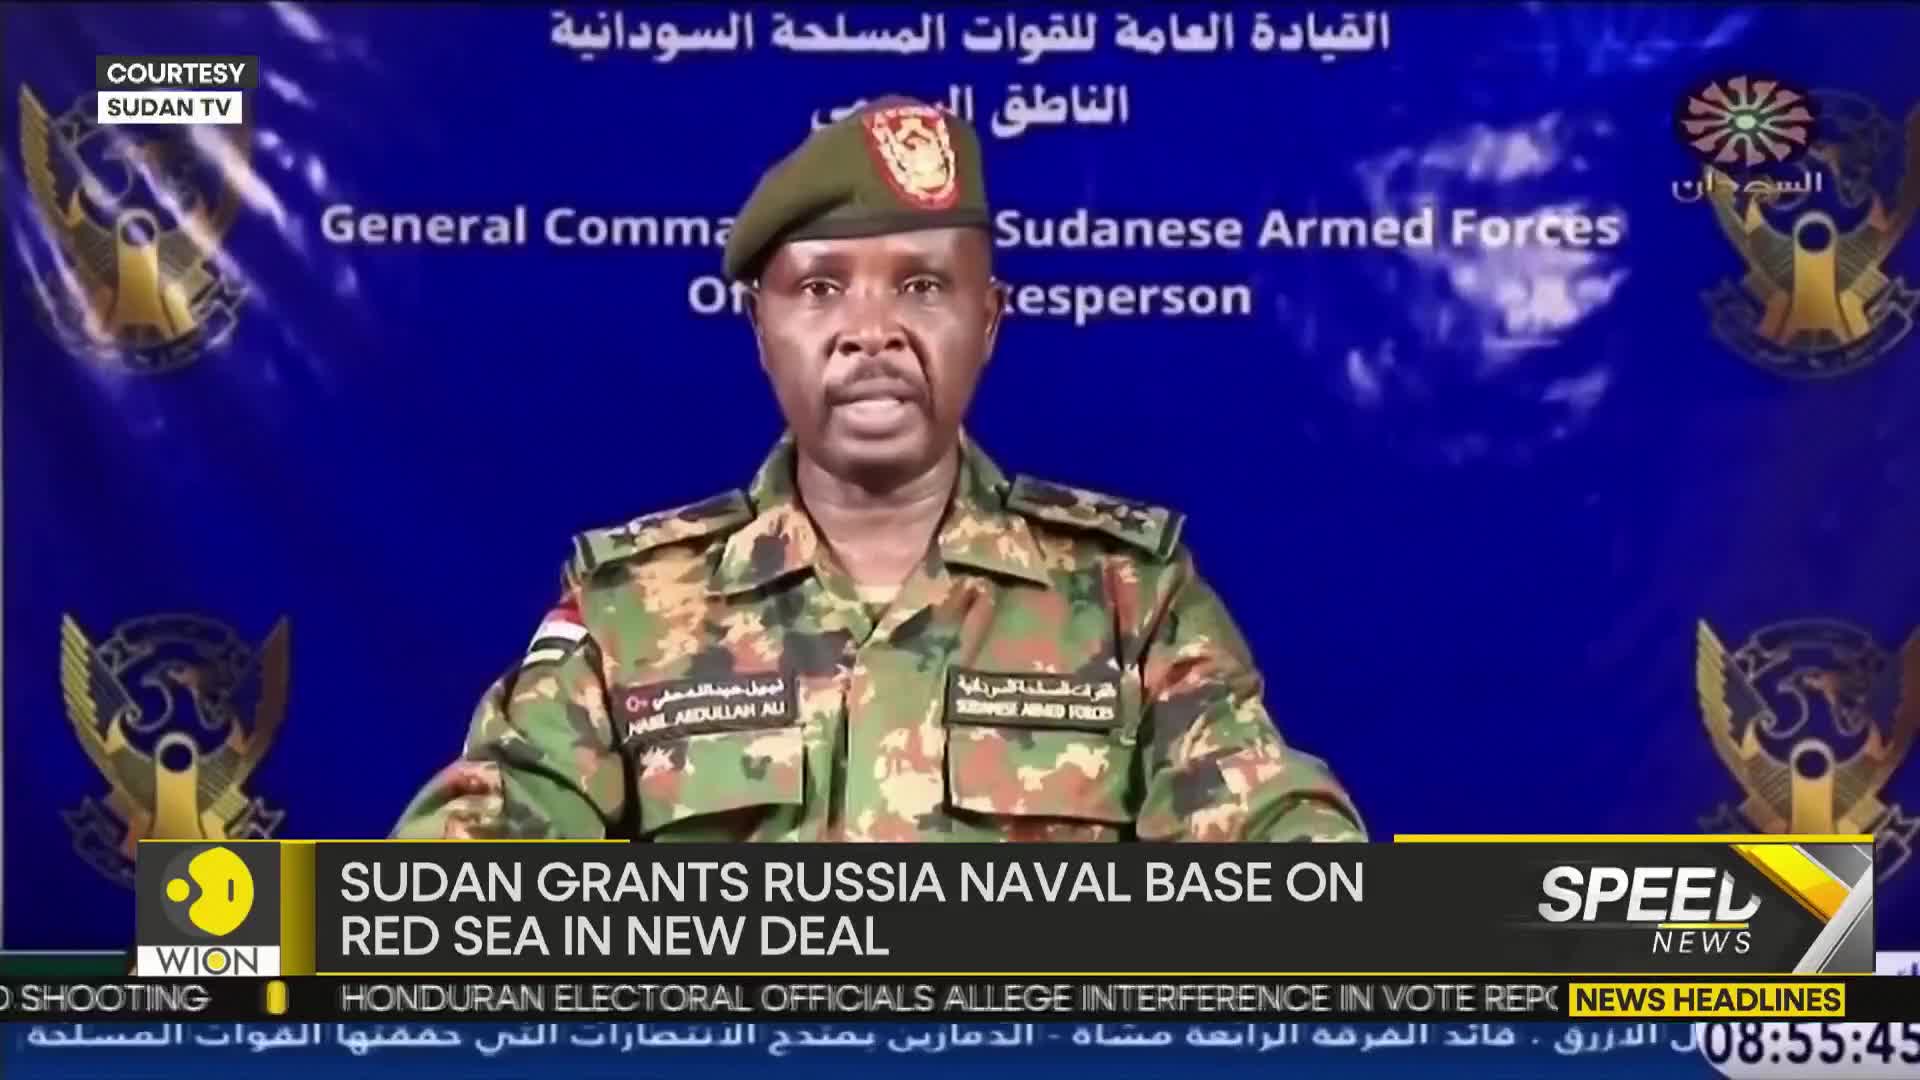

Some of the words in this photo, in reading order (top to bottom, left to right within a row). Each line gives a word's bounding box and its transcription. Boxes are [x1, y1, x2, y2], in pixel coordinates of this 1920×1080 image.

[551, 11, 754, 63] السودانية
[771, 13, 945, 54] المسلحة
[962, 13, 1097, 64] للقوات
[1115, 12, 1234, 55] العامة
[1250, 11, 1390, 62] القيادة
[991, 84, 1129, 138] الناطق
[320, 204, 526, 245] General
[544, 208, 737, 246] Comma
[995, 209, 1243, 248] Sudanese
[1258, 208, 1433, 247] Armed
[1452, 208, 1622, 248] Forces
[759, 700, 785, 718] ALI
